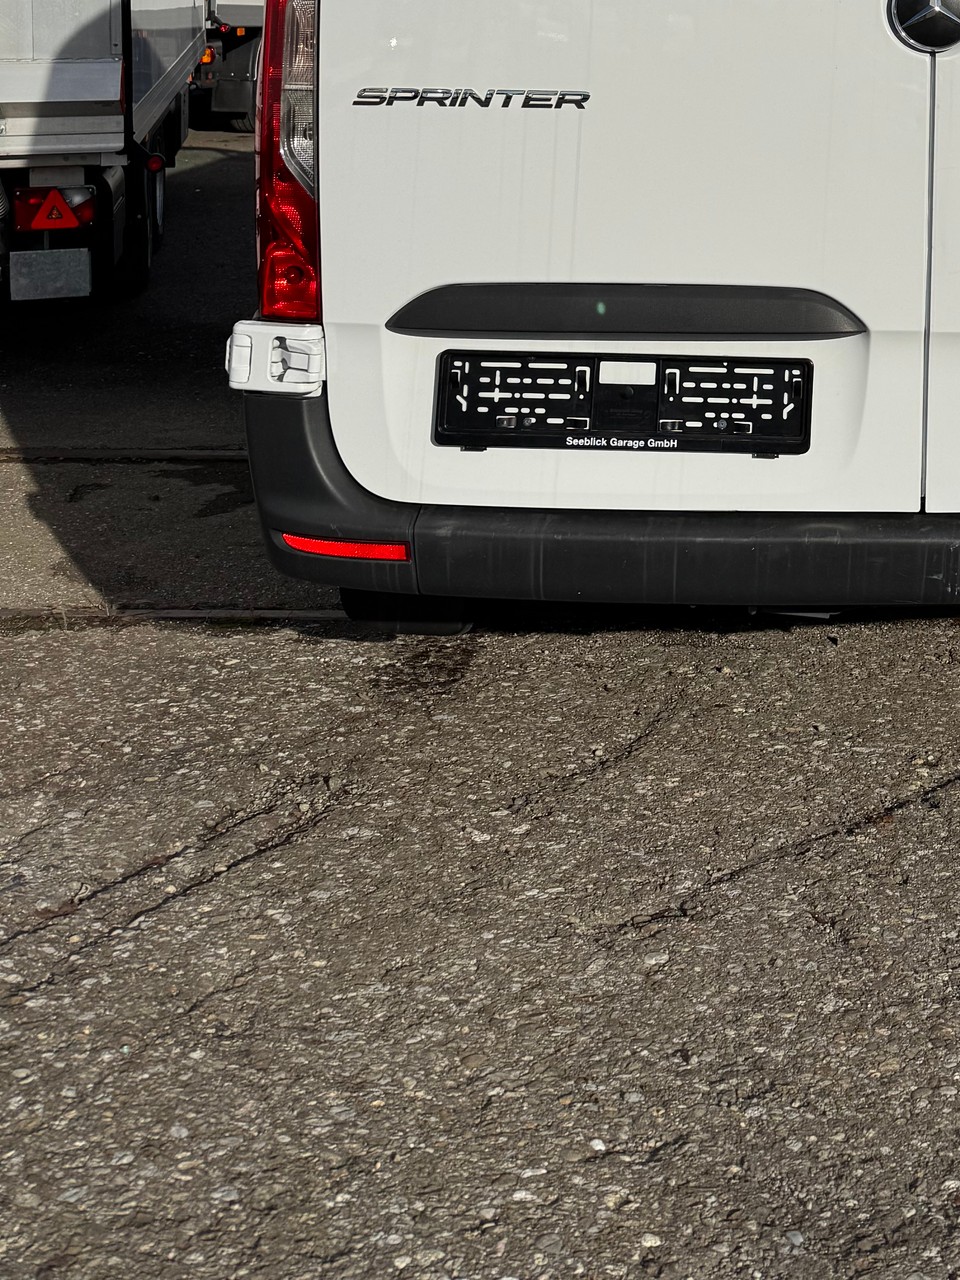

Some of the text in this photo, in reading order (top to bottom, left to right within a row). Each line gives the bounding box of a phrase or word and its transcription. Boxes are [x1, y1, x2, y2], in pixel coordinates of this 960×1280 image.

[352, 87, 591, 110] SPRINTER
[566, 436, 678, 449] Seeblick Garage GmbH
